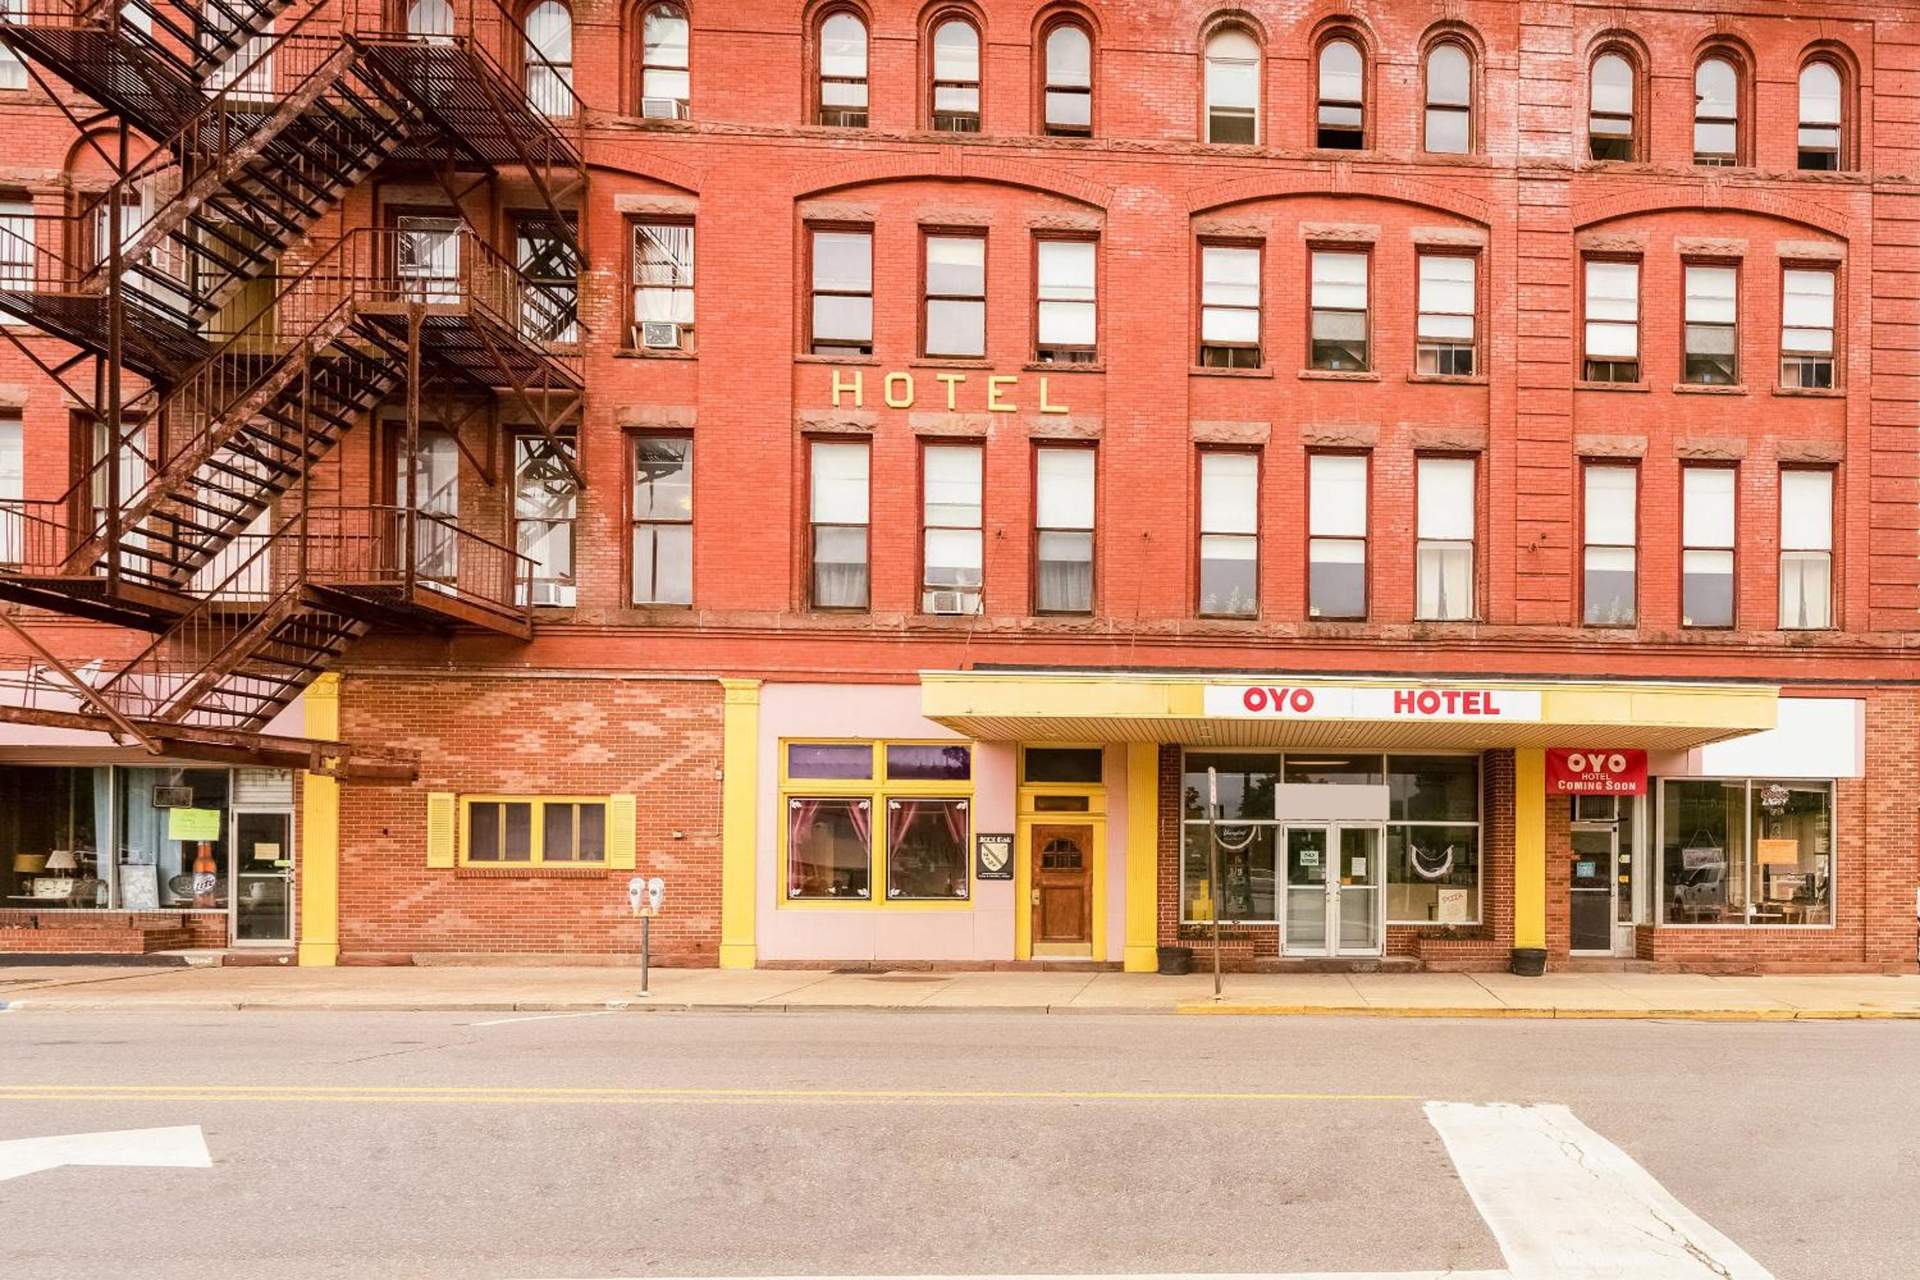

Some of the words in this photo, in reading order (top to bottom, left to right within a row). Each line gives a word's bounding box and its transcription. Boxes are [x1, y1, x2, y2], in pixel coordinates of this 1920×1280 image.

[832, 370, 1069, 413] HOTEL
[1243, 687, 1314, 713] OYO
[1393, 690, 1500, 715] HOTEL
[1567, 753, 1627, 772] OYO
